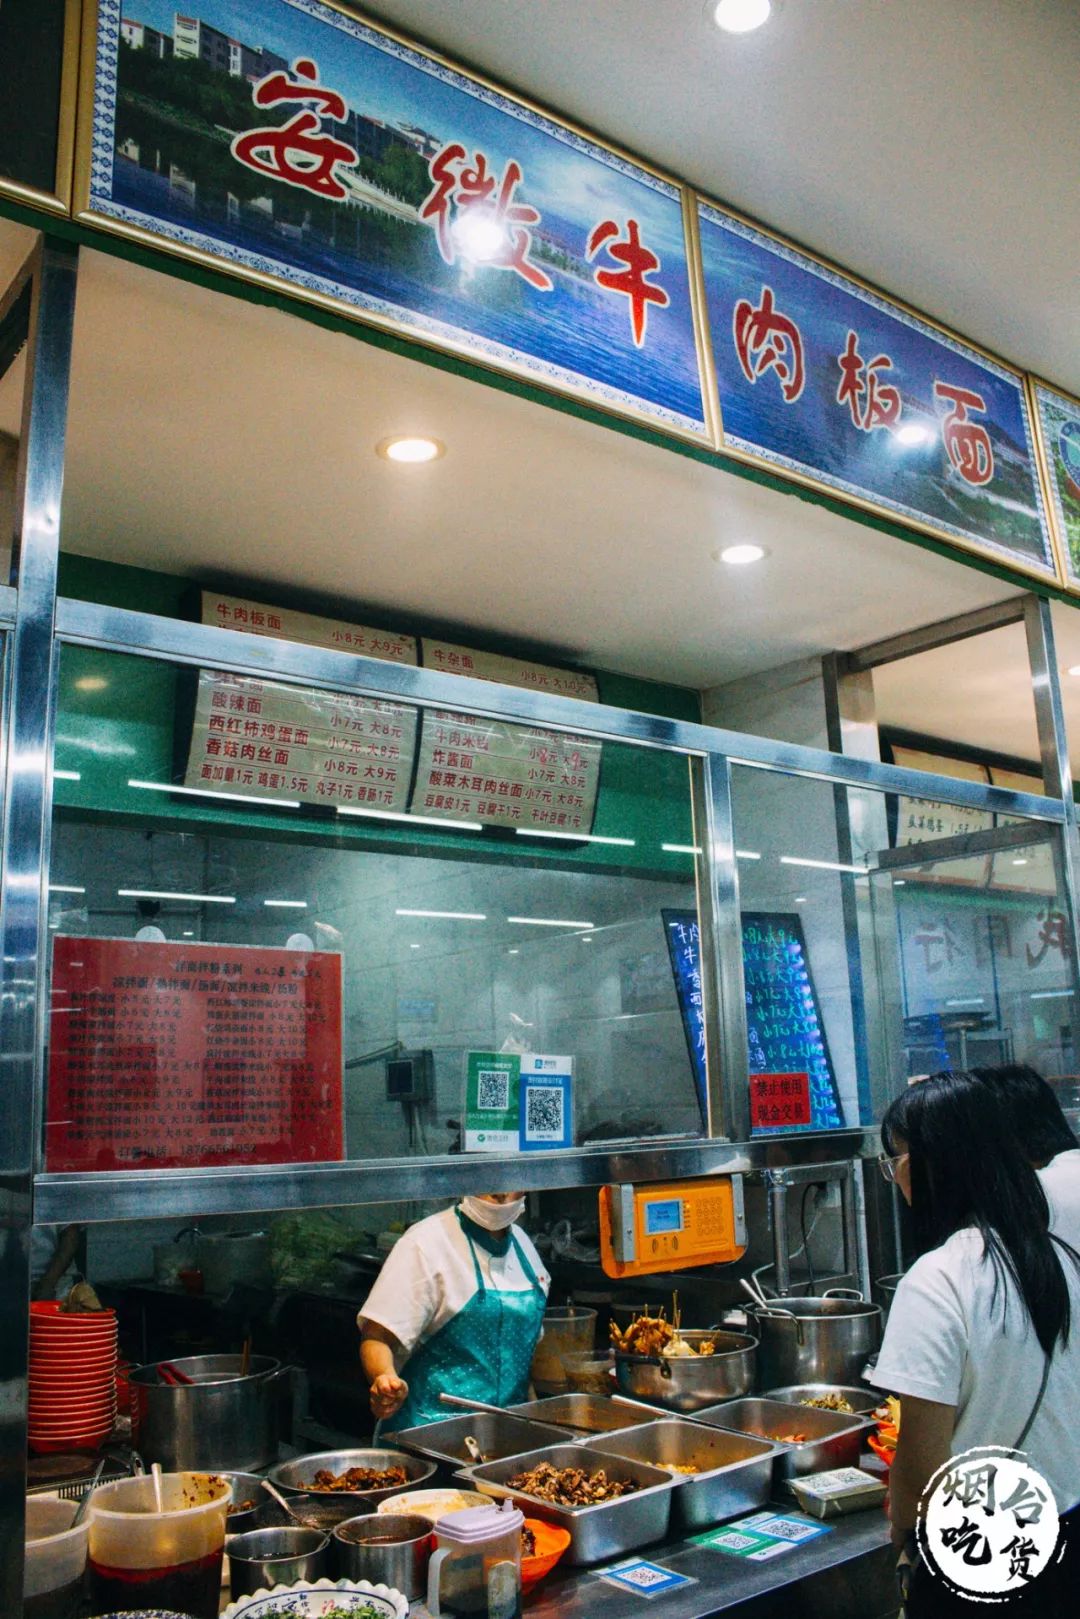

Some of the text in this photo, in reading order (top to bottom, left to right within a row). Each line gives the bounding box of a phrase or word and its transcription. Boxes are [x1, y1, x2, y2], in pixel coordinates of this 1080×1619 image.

[231, 57, 995, 486] 安徽牛肉板面
[217, 603, 282, 630] 牛肉板面
[332, 631, 366, 648] 小8元
[370, 639, 404, 656] 大9元
[432, 649, 474, 669] 牛杂面
[212, 692, 402, 738] 酸辣面 小7元 大8元
[208, 715, 400, 759] 西红柿鸡蛋面 小7元 大8元
[206, 738, 397, 782] 香菇肉丝面 小8元 大9元
[432, 748, 586, 788] 炸酱面 小7元 大8元
[201, 764, 394, 805] 面加量1元 鸡蛋1.5元 丸子1元 香肠1元
[429, 770, 583, 808] 酸菜木耳肉丝面 小7元 大8元
[424, 793, 471, 812] 豆腐皮1元
[477, 800, 521, 819] 豆腐干1元
[756, 1078, 803, 1096] 禁止使用
[757, 1102, 804, 1120] 现金交易
